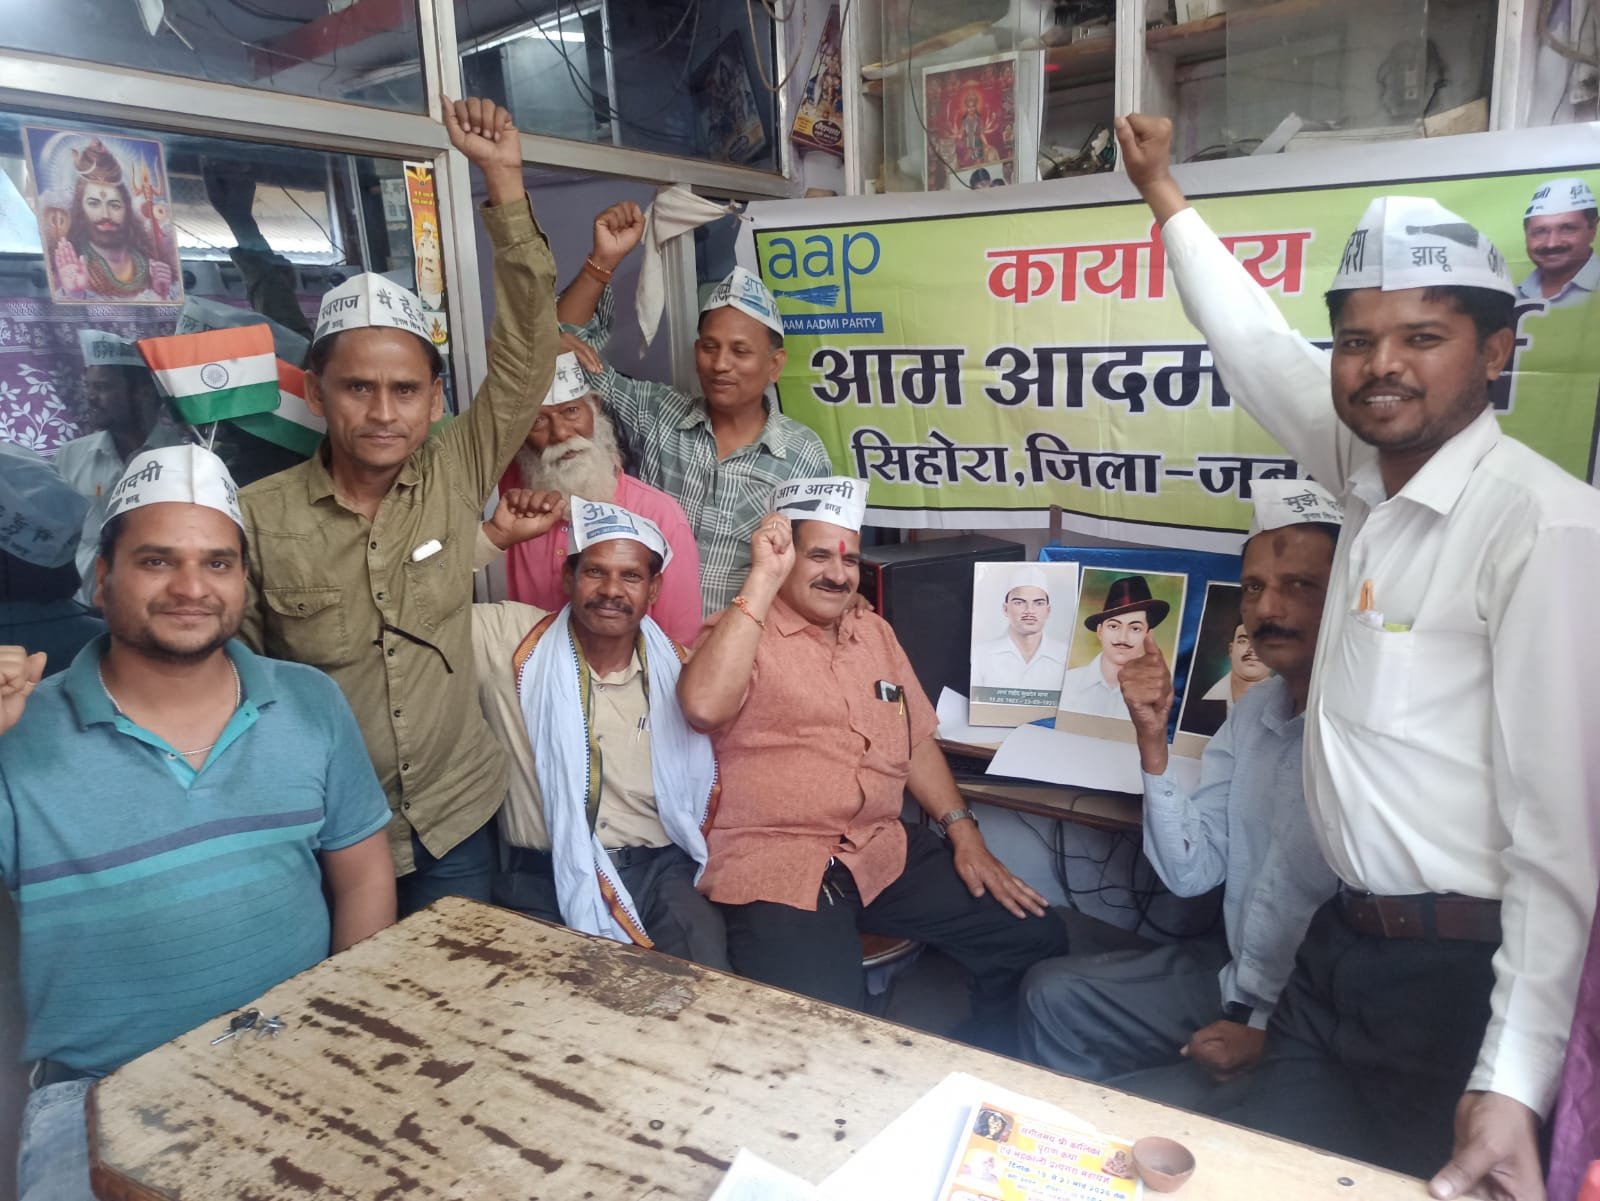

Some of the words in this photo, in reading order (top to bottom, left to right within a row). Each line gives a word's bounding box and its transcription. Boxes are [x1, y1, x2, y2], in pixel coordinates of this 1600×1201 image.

[768, 232, 880, 313] aap
[783, 320, 804, 330] AAM
[806, 319, 840, 330] AADMI
[842, 318, 877, 329] PARTY
[811, 346, 965, 407] आम
[984, 345, 1232, 413] आदम
[805, 480, 855, 499] आदमी
